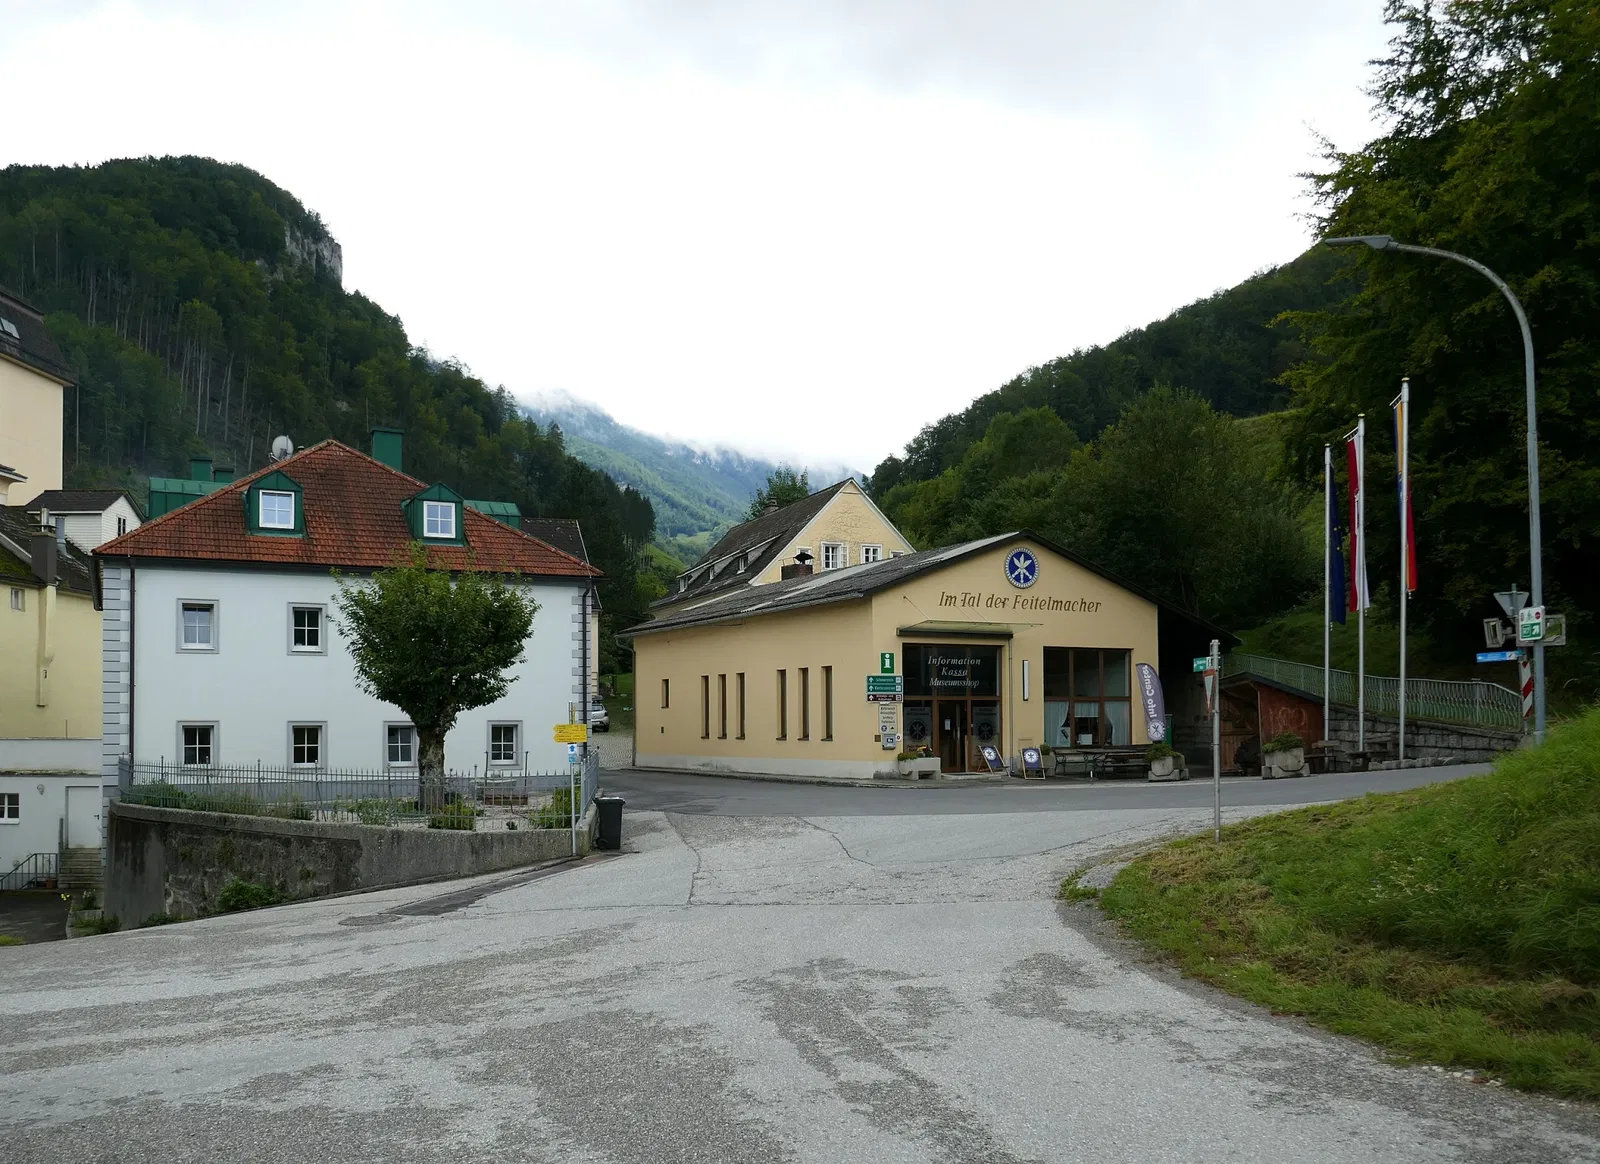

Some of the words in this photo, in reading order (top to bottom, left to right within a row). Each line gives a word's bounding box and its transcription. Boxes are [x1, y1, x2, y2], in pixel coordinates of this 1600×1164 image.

[938, 591, 957, 607] Im
[960, 592, 982, 608] Tal
[985, 593, 1010, 609] der
[1012, 594, 1102, 613] Feitelmacher
[928, 655, 982, 667] Information
[941, 667, 968, 677] Kassa
[929, 677, 980, 689] Museumsshop
